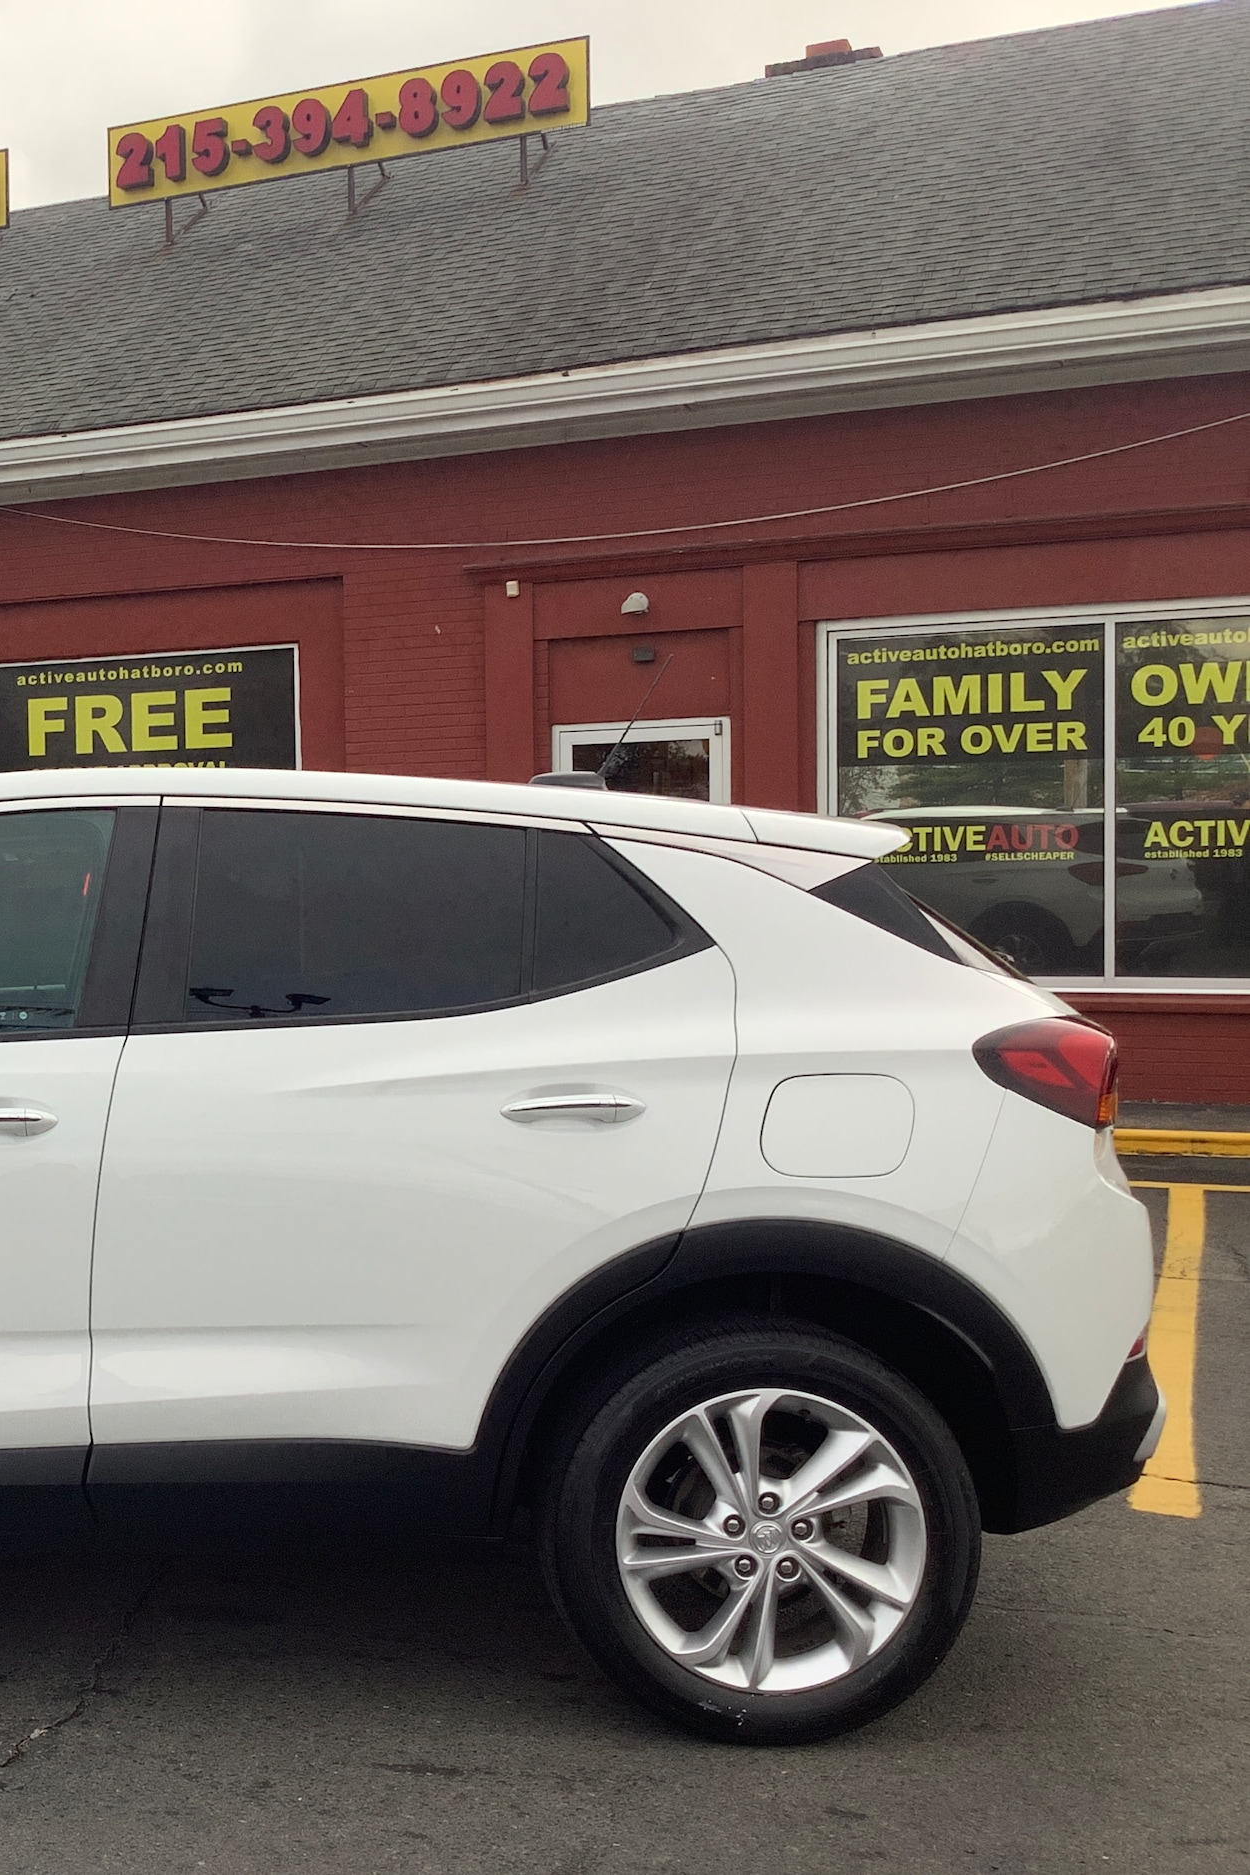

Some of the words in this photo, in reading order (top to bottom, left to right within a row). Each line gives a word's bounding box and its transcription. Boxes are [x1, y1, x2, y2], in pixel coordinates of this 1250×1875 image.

[116, 52, 570, 191] 215-394-8922
[847, 638, 1099, 664] activeautohatboro.com
[1123, 628, 1250, 649] activeauto
[17, 661, 243, 686] activeautohatboro.com
[1131, 660, 1250, 707] OW
[857, 669, 1088, 720] FAMILY
[27, 687, 232, 756] FREE
[1138, 716, 1195, 748] 40
[1211, 714, 1250, 745] Y
[857, 727, 947, 759] FOR
[960, 721, 1088, 755] OVER
[930, 853, 957, 863] 1983
[985, 851, 1075, 861] #SELLSCHEAPER
[1144, 849, 1209, 859] established
[1212, 848, 1243, 857] 1983
